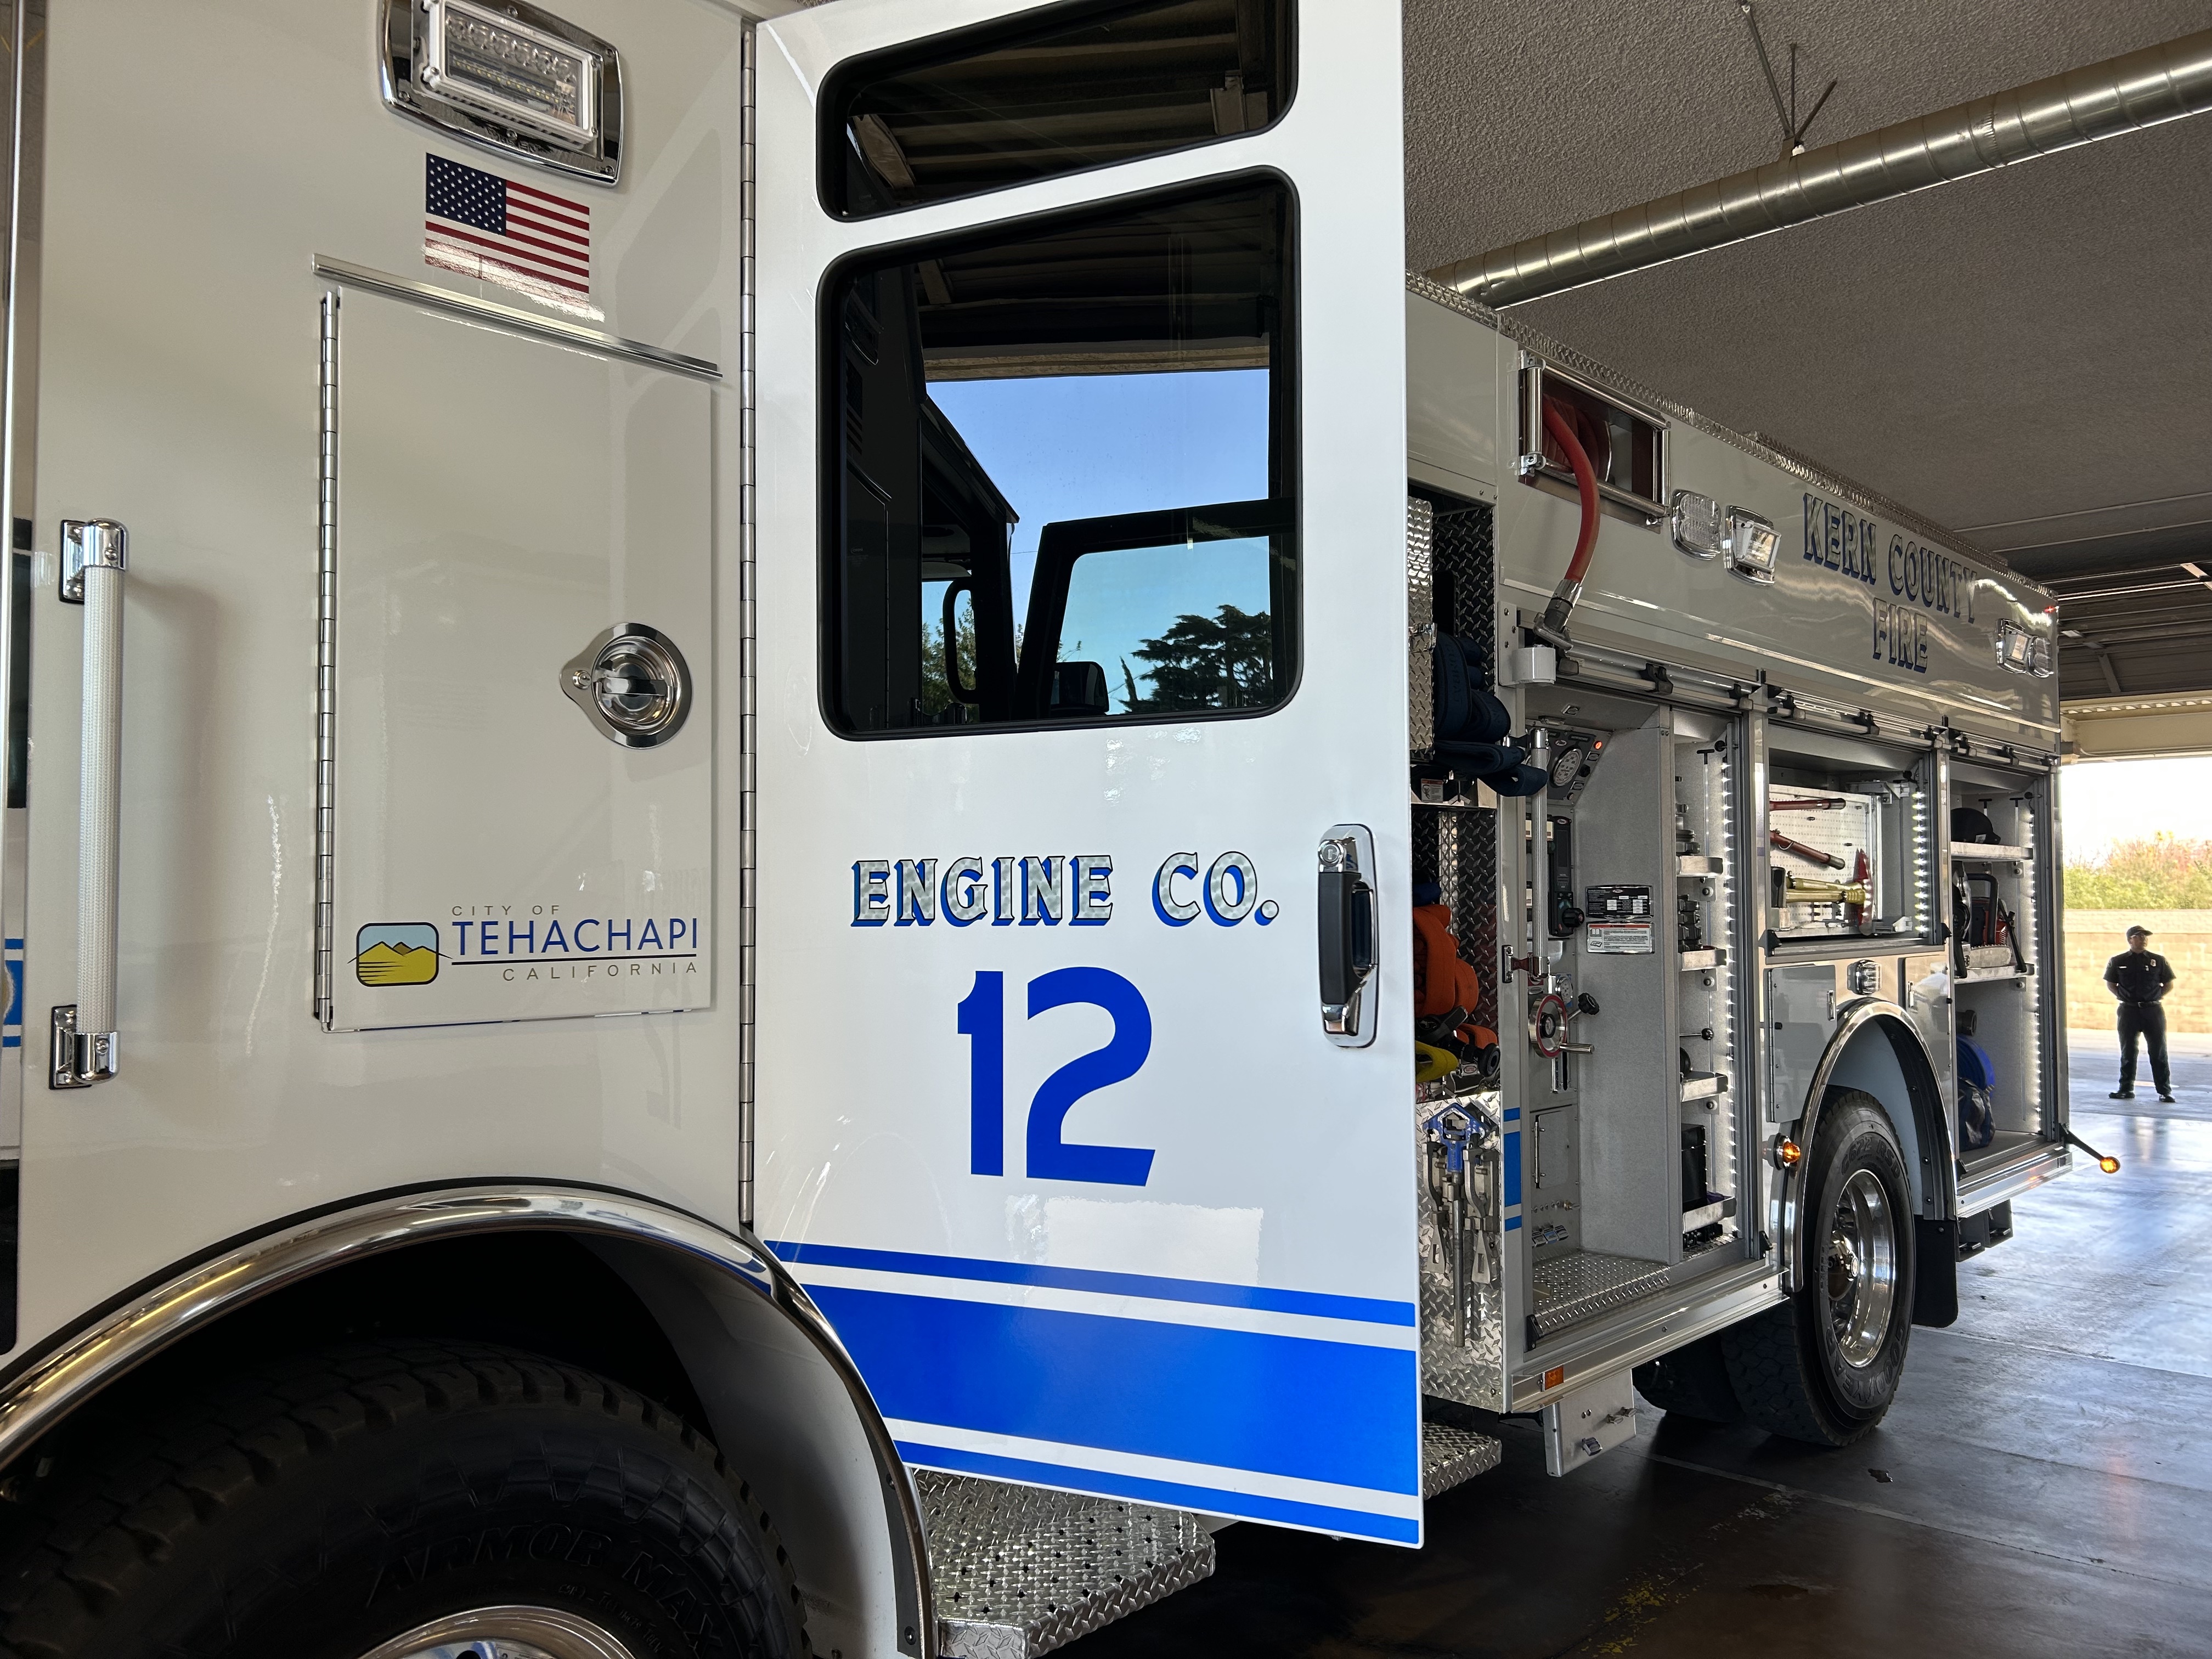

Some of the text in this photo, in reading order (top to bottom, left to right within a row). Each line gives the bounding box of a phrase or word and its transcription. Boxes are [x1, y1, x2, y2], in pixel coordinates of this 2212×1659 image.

[1803, 493, 1977, 623] KERN COUNTY
[1872, 597, 1928, 673] FIRE
[452, 905, 560, 916] CITY OF
[851, 851, 1280, 927] ENGINE CO.
[452, 918, 697, 956] TEHACHAPI
[503, 962, 697, 981] CALIFORNIA
[957, 966, 1156, 1187] 12
[366, 1523, 614, 1608] ARMOR
[620, 1550, 724, 1659] MAX
